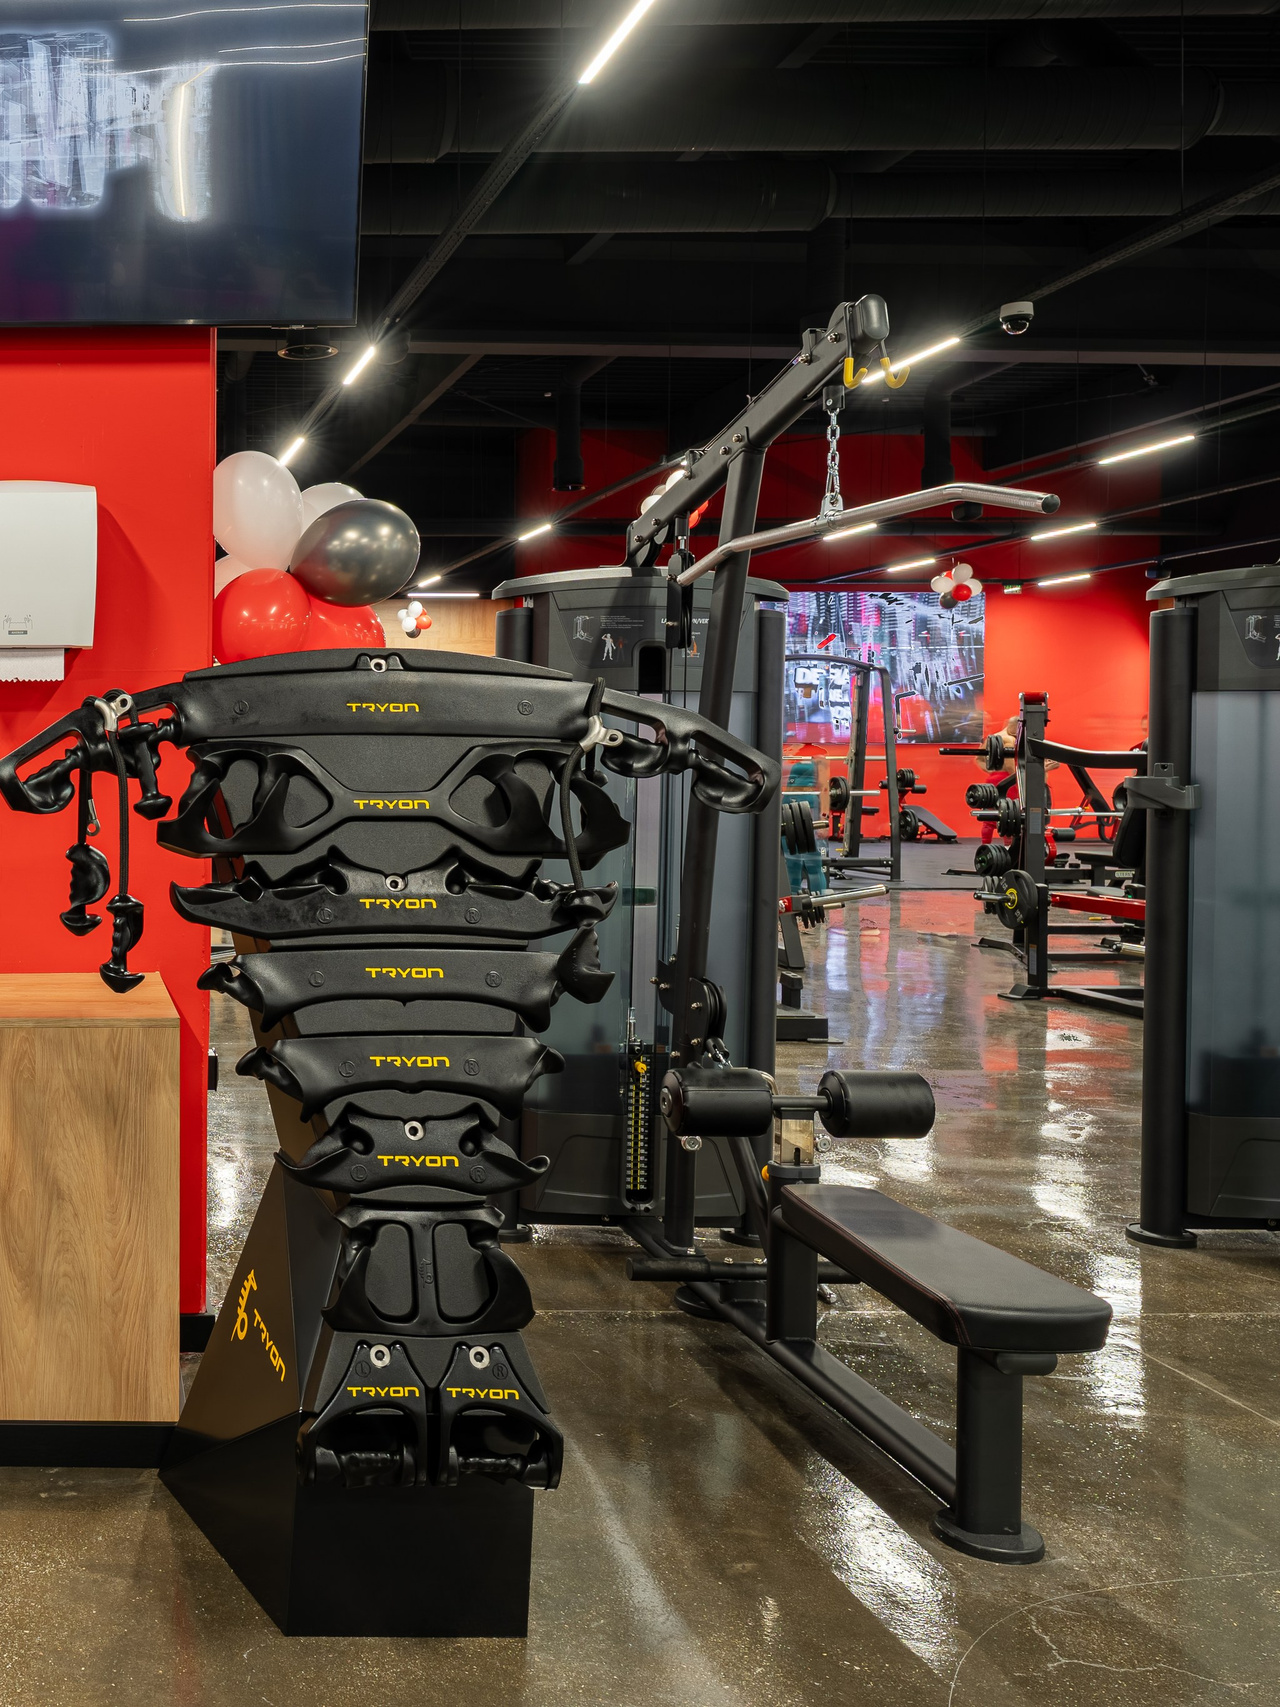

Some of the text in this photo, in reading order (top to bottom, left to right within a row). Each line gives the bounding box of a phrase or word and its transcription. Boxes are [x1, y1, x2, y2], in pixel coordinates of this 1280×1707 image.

[345, 702, 420, 713] TRYON
[353, 799, 430, 810] TRYON
[359, 898, 438, 910] TRYON
[364, 967, 445, 979] TRYON
[369, 1055, 451, 1068] TRYON
[376, 1154, 460, 1168] TRYON
[253, 1308, 286, 1382] TRYON
[346, 1386, 420, 1398] TRYON
[445, 1387, 520, 1401] TRYON
